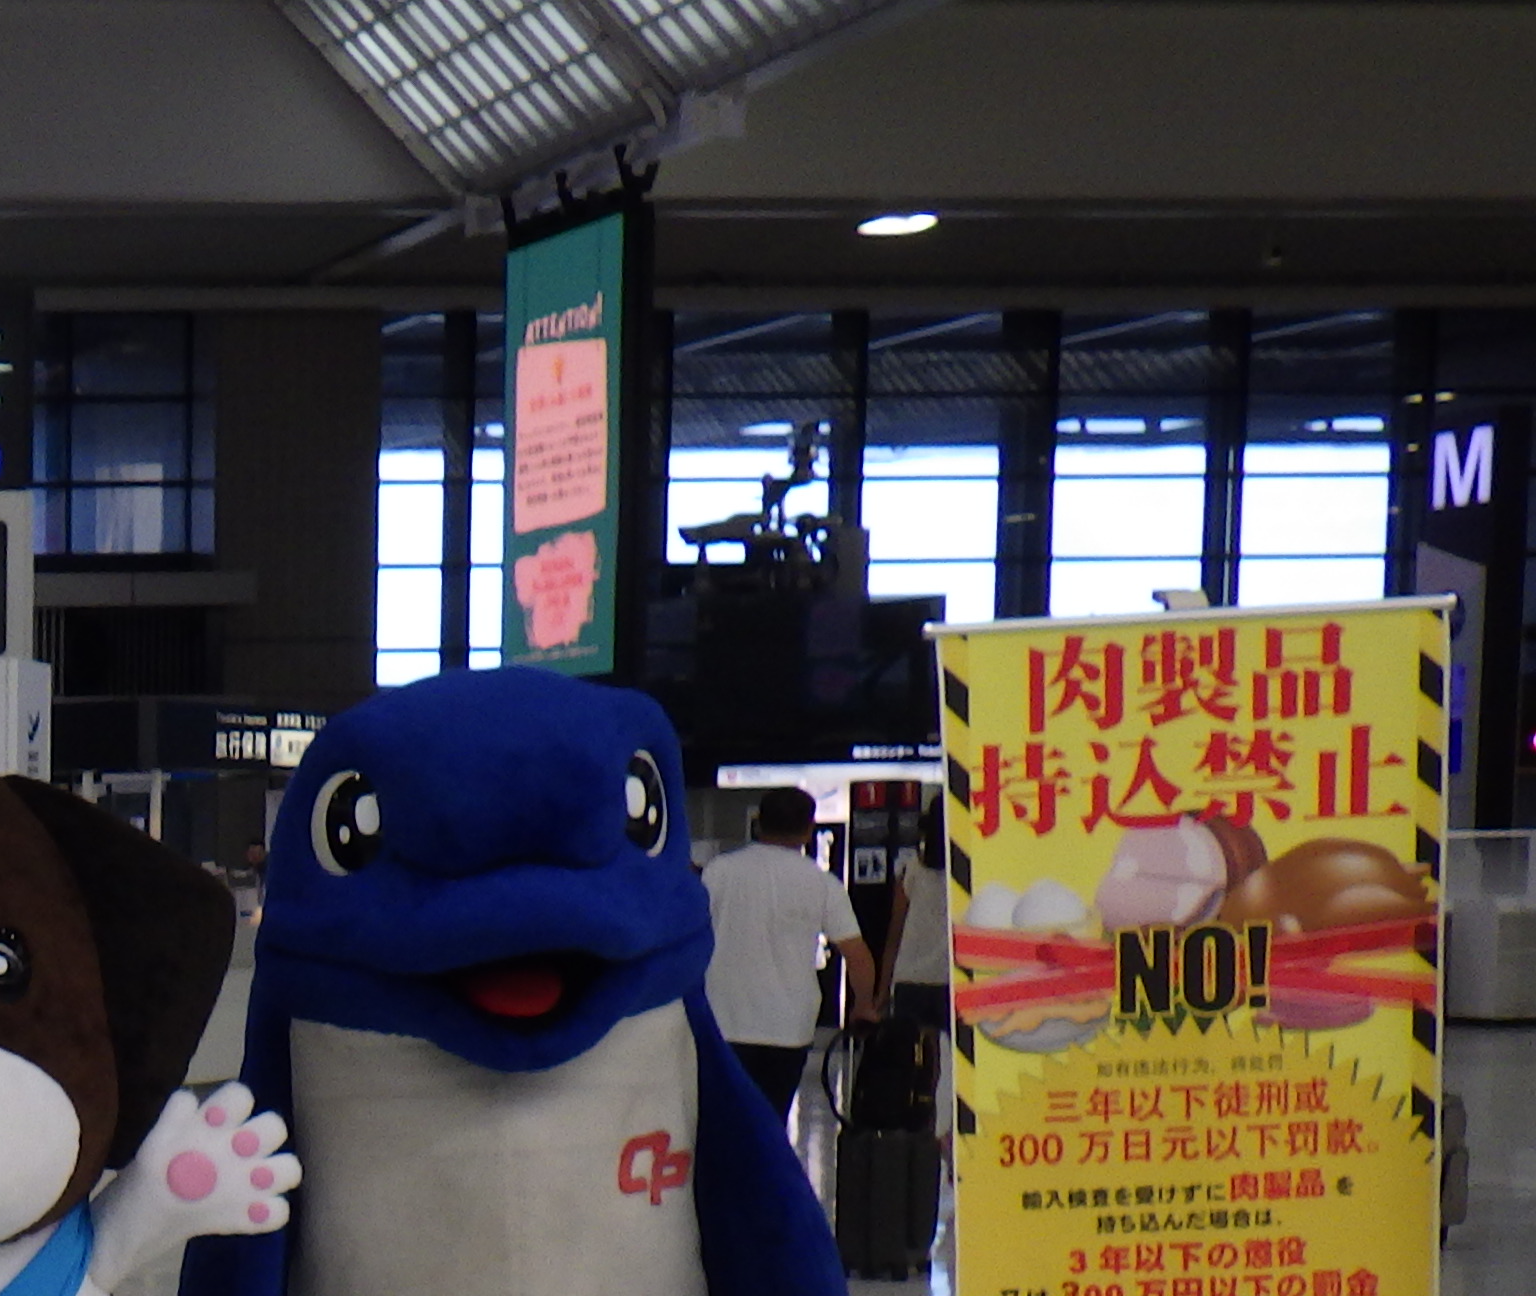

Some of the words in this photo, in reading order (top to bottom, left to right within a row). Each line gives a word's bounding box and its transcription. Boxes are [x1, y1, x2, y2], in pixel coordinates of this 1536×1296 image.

[1433, 425, 1494, 511] M
[1028, 622, 1353, 735] 肉製品
[973, 726, 1411, 838] 持込禁止
[1116, 922, 1272, 1016] NO!
[1044, 1077, 1330, 1124] 三年以下徒刑或
[999, 1133, 1064, 1168] 300
